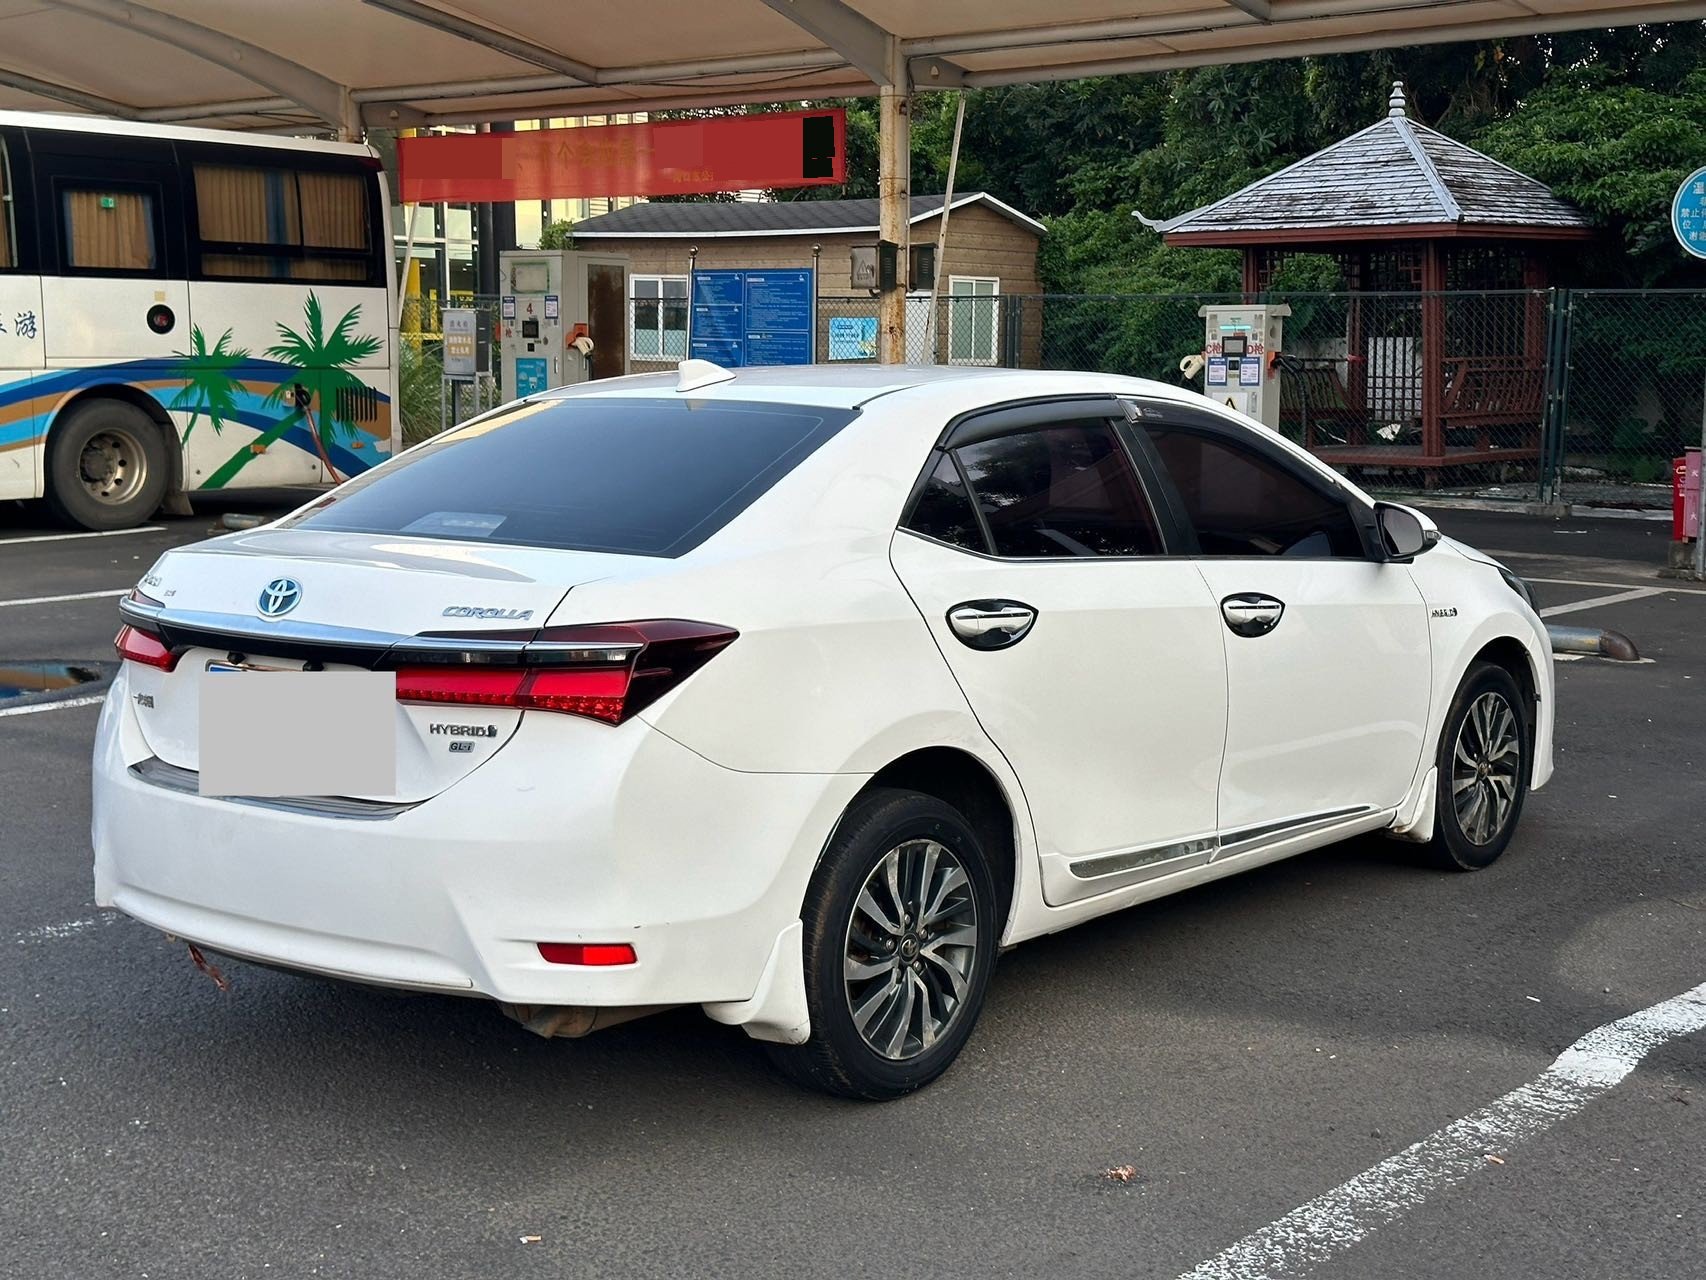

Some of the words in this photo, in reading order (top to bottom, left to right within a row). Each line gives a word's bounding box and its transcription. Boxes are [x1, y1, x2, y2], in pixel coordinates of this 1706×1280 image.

[526, 303, 533, 314] 4
[0, 310, 37, 339] 游
[442, 606, 534, 621] COROLLA
[429, 723, 487, 738] HYBRID
[450, 742, 473, 751] GL-i
